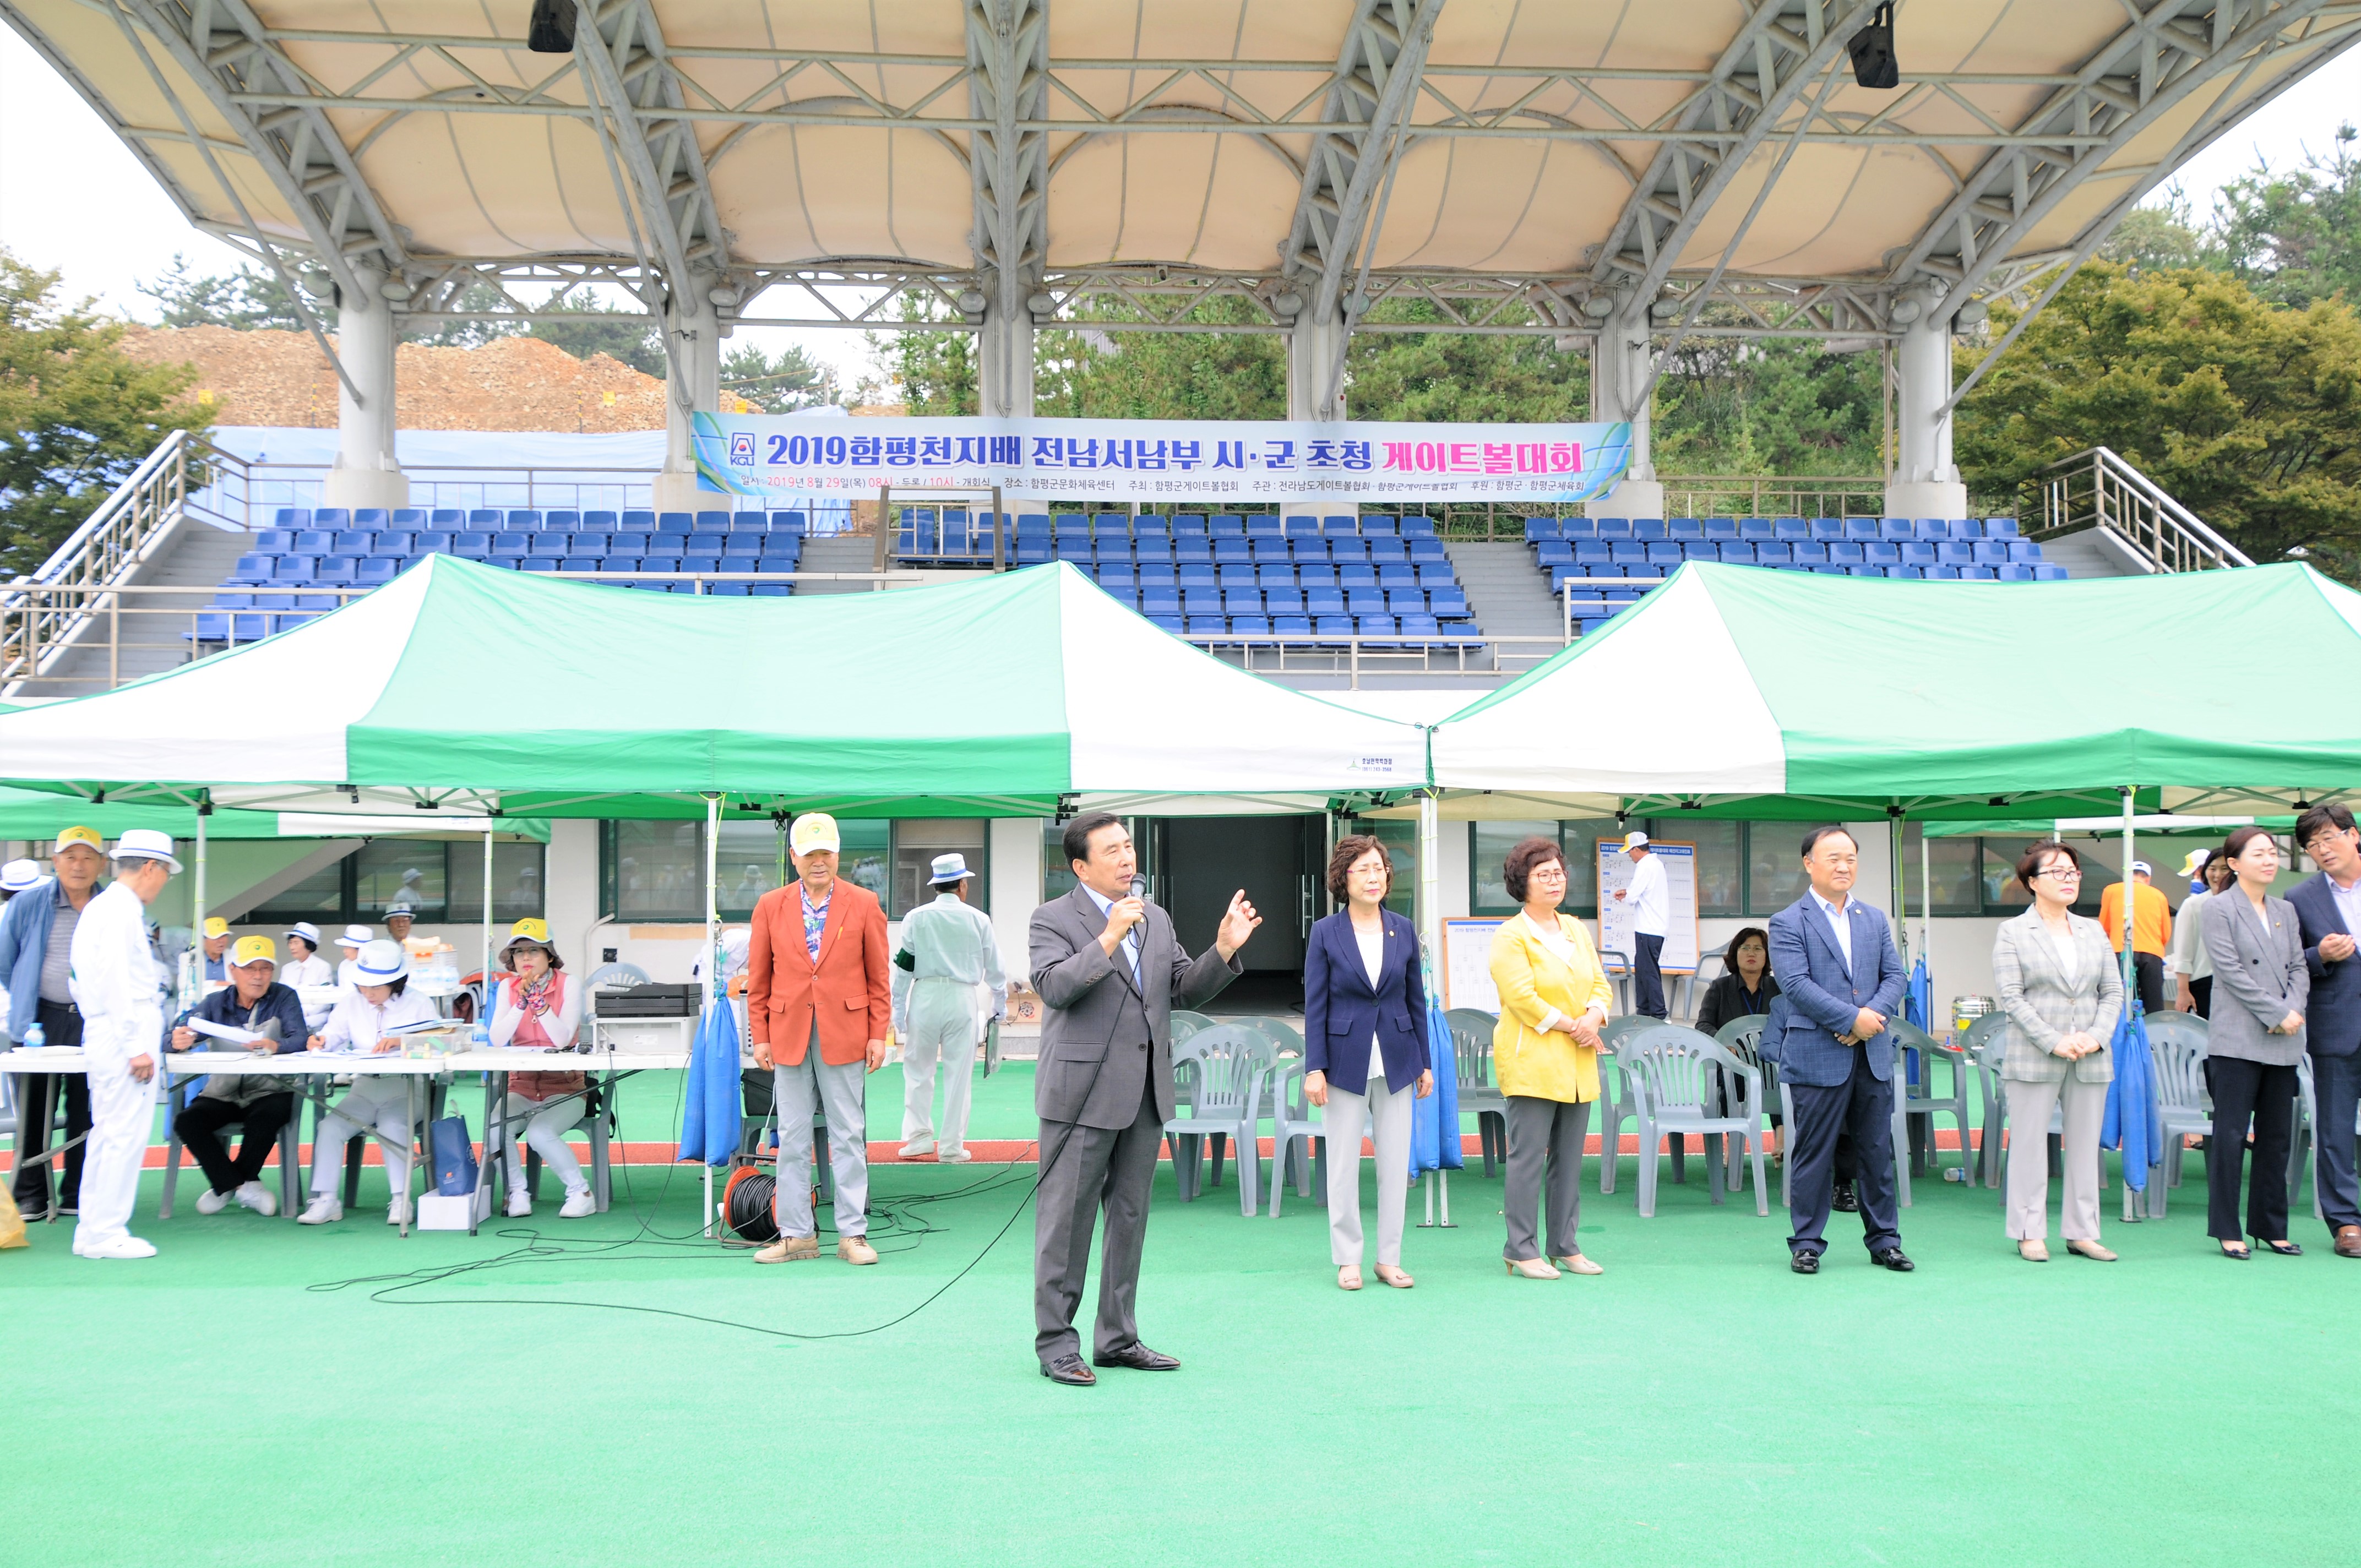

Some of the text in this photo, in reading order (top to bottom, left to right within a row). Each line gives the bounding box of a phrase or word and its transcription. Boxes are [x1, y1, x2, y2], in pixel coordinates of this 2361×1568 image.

[768, 434, 1021, 465] 2019함평천지배
[1031, 437, 1202, 470] 전남서남부
[1307, 440, 1371, 470] 초청
[1381, 442, 1582, 474] 게이트볼대회
[730, 456, 754, 466] KGU
[741, 475, 759, 486] 일시
[768, 477, 804, 488] 2019년
[807, 477, 823, 488] 8월
[826, 477, 866, 489] 29일(목)
[868, 476, 893, 488] 08시
[930, 476, 953, 486] 10시
[963, 477, 990, 486] 개회식
[1004, 477, 1023, 488] 장소
[1031, 478, 1115, 490] 함평군문화체육센터
[1129, 480, 1147, 491] 주최
[1155, 480, 1238, 492] 함평군게이트볼협회
[1252, 481, 1271, 491] 주관
[1279, 480, 1370, 492] 전라남도게이트볼협회
[1471, 481, 1489, 491] 후원
[1530, 480, 1585, 491] 함평군체육회
